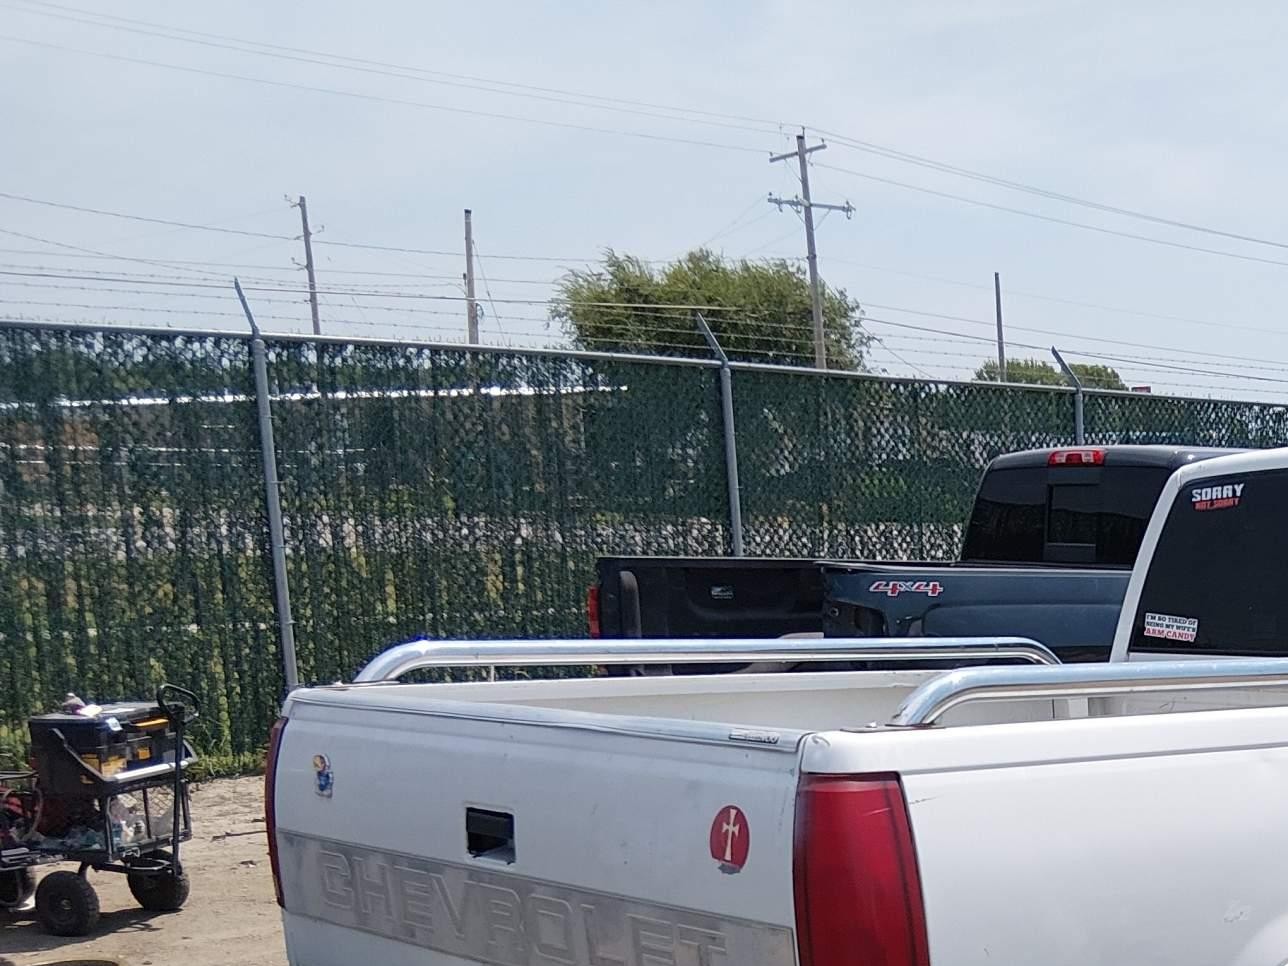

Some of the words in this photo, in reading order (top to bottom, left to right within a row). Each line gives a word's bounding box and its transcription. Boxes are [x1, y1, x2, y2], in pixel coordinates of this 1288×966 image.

[1191, 483, 1245, 502] SORRY
[1168, 617, 1187, 625] TIRED
[1146, 628, 1165, 636] ARM
[1166, 630, 1195, 641] CANDY
